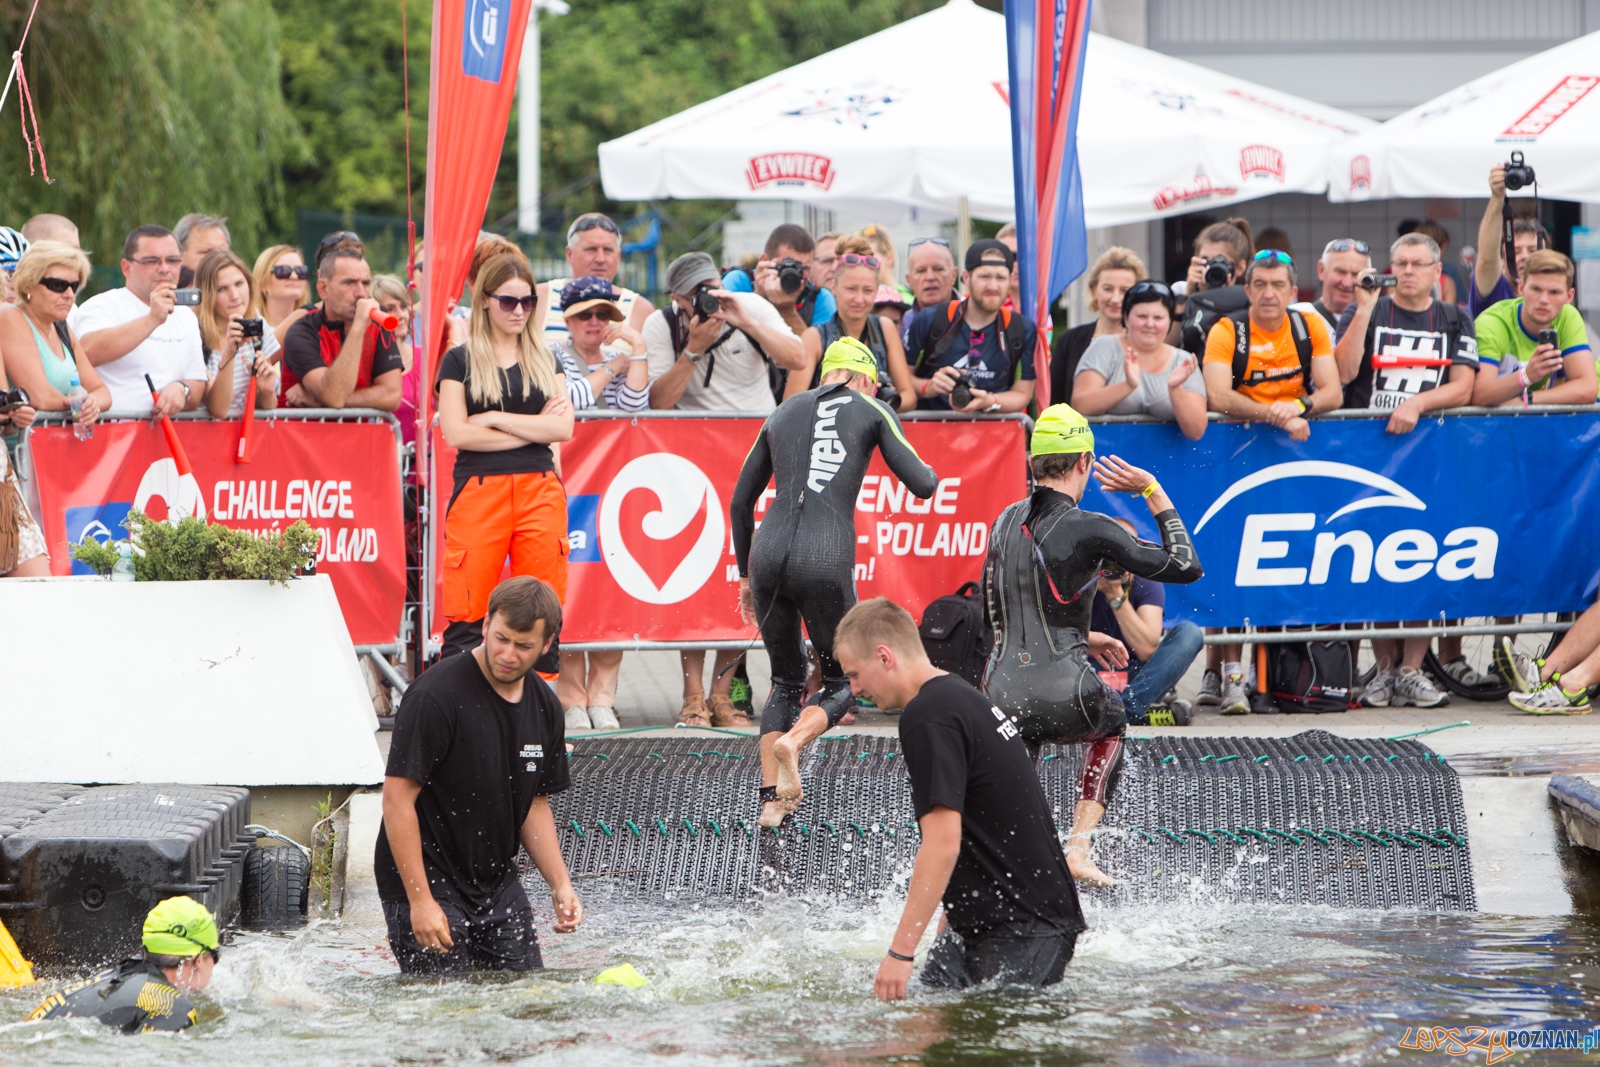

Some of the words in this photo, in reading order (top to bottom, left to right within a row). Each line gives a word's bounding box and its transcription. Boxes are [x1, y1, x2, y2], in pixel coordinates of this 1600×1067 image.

[806, 395, 853, 494] arena
[1069, 426, 1092, 435] FIN
[213, 479, 354, 520] CHALLENGE
[305, 527, 379, 563] OLAND
[877, 521, 987, 557] POLAND
[1235, 512, 1499, 588] Enea
